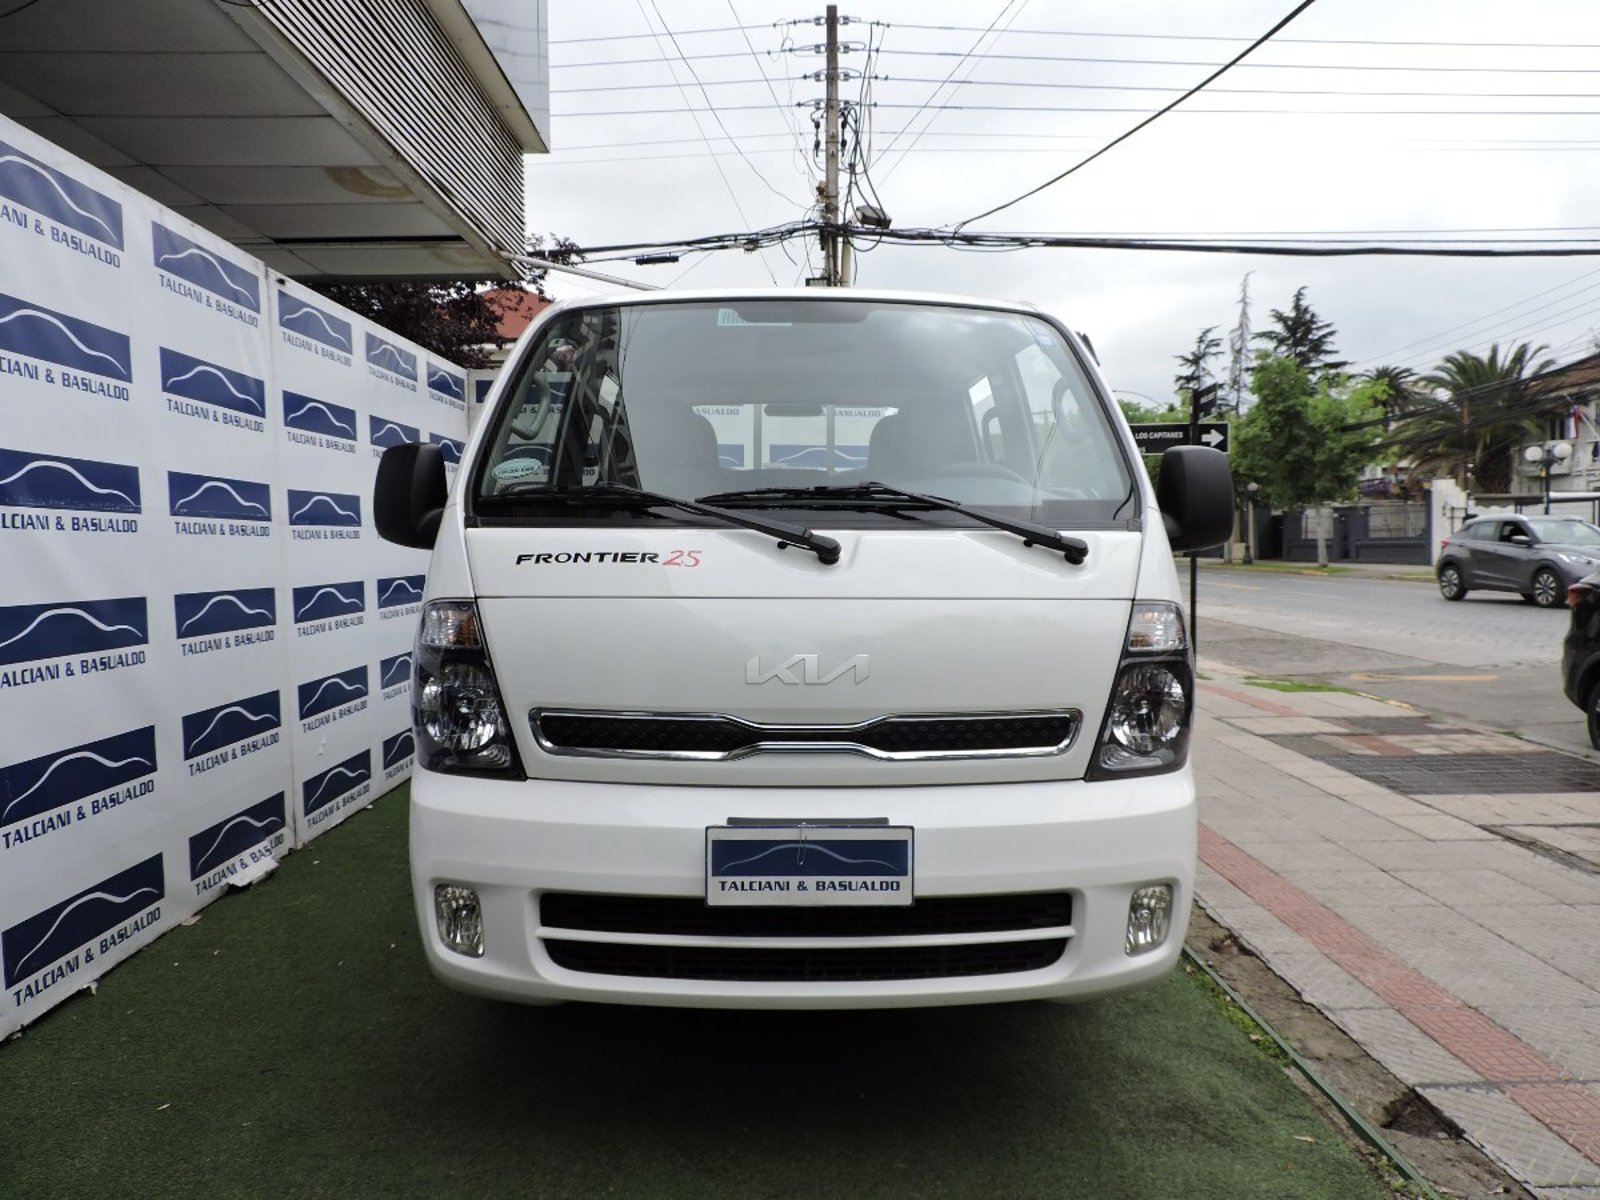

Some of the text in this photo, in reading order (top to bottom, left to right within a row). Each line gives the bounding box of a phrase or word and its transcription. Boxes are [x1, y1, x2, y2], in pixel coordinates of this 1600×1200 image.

[34, 219, 45, 236] &
[51, 226, 121, 269] BASUALDO
[159, 274, 259, 328] TALCIANI & BASUALDO
[45, 369, 56, 384] &
[61, 371, 130, 401] BASUALDO
[167, 398, 265, 432] TALCIANI & BASUALDO
[1149, 431, 1184, 439] CAPITANES
[2, 513, 138, 533] LCIANI & BASUALDO
[175, 521, 270, 537] TALCIANI & BASUALDO
[515, 550, 703, 568] FRONTIER 25
[181, 630, 275, 656] TALCIANI & BASUALDO
[0, 651, 146, 688] ALCIANI & BASUALDO
[745, 654, 871, 685] KIA
[189, 732, 280, 776] TALCIANI & BASUALDO
[2, 779, 155, 849] TALCIANI & BASUALDO
[195, 862, 238, 896] TALCIANI
[240, 858, 249, 869] &
[718, 880, 900, 892] TALCIANI & BASUALDO
[13, 906, 161, 1007] TALCIANI & BASUALDO
